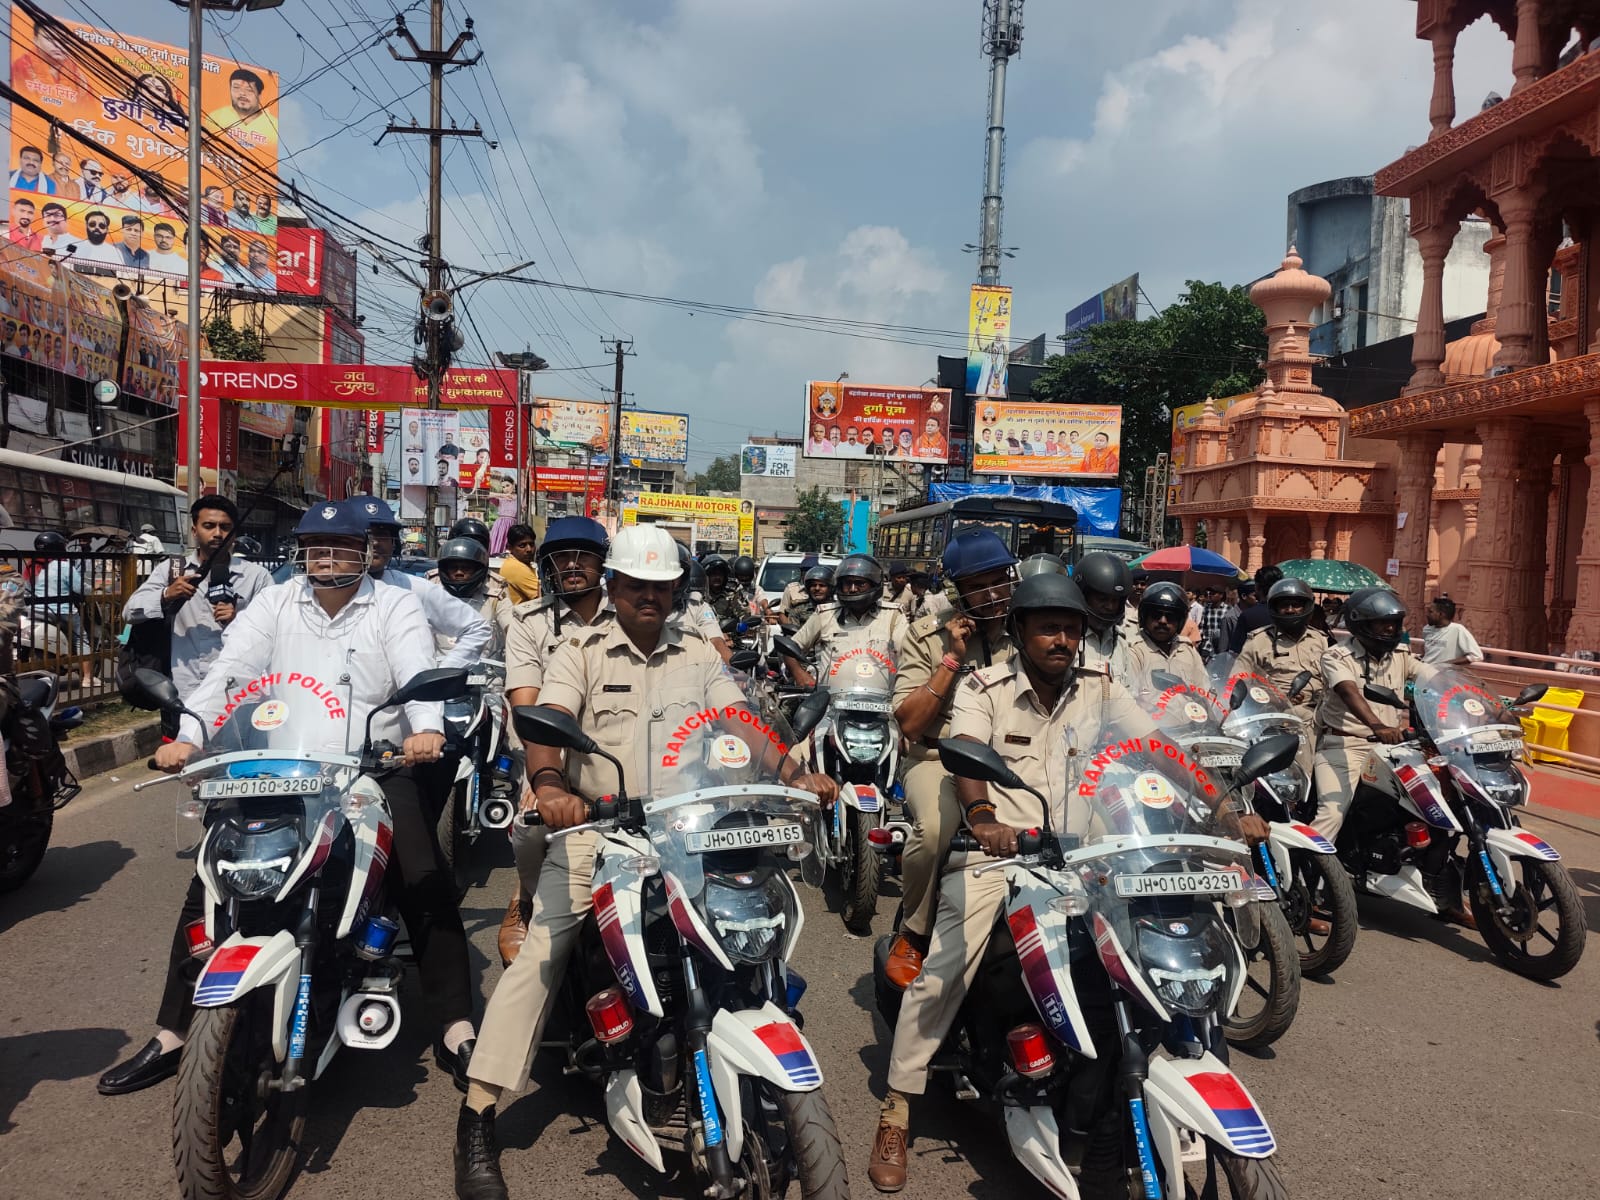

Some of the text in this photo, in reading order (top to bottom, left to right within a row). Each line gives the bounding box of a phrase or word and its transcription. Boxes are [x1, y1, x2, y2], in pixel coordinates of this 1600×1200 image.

[151, 46, 169, 63] दुर्गा
[209, 372, 298, 390] TRENDS
[474, 373, 488, 383] की
[863, 403, 907, 416] दुर्गा पूजा
[640, 497, 692, 509] RAJDHANI
[695, 502, 737, 512] MOTORS
[646, 551, 658, 565] P
[829, 648, 863, 676] RANCHI
[213, 672, 346, 728] RANCHI POLICE
[661, 706, 790, 768] RANCHI POLICE
[1078, 738, 1217, 797] RANCHI POLICE
[619, 969, 635, 993] 112
[1044, 996, 1065, 1026] 112
[607, 1020, 629, 1035] GARUD
[1029, 1053, 1051, 1068] GARUD
